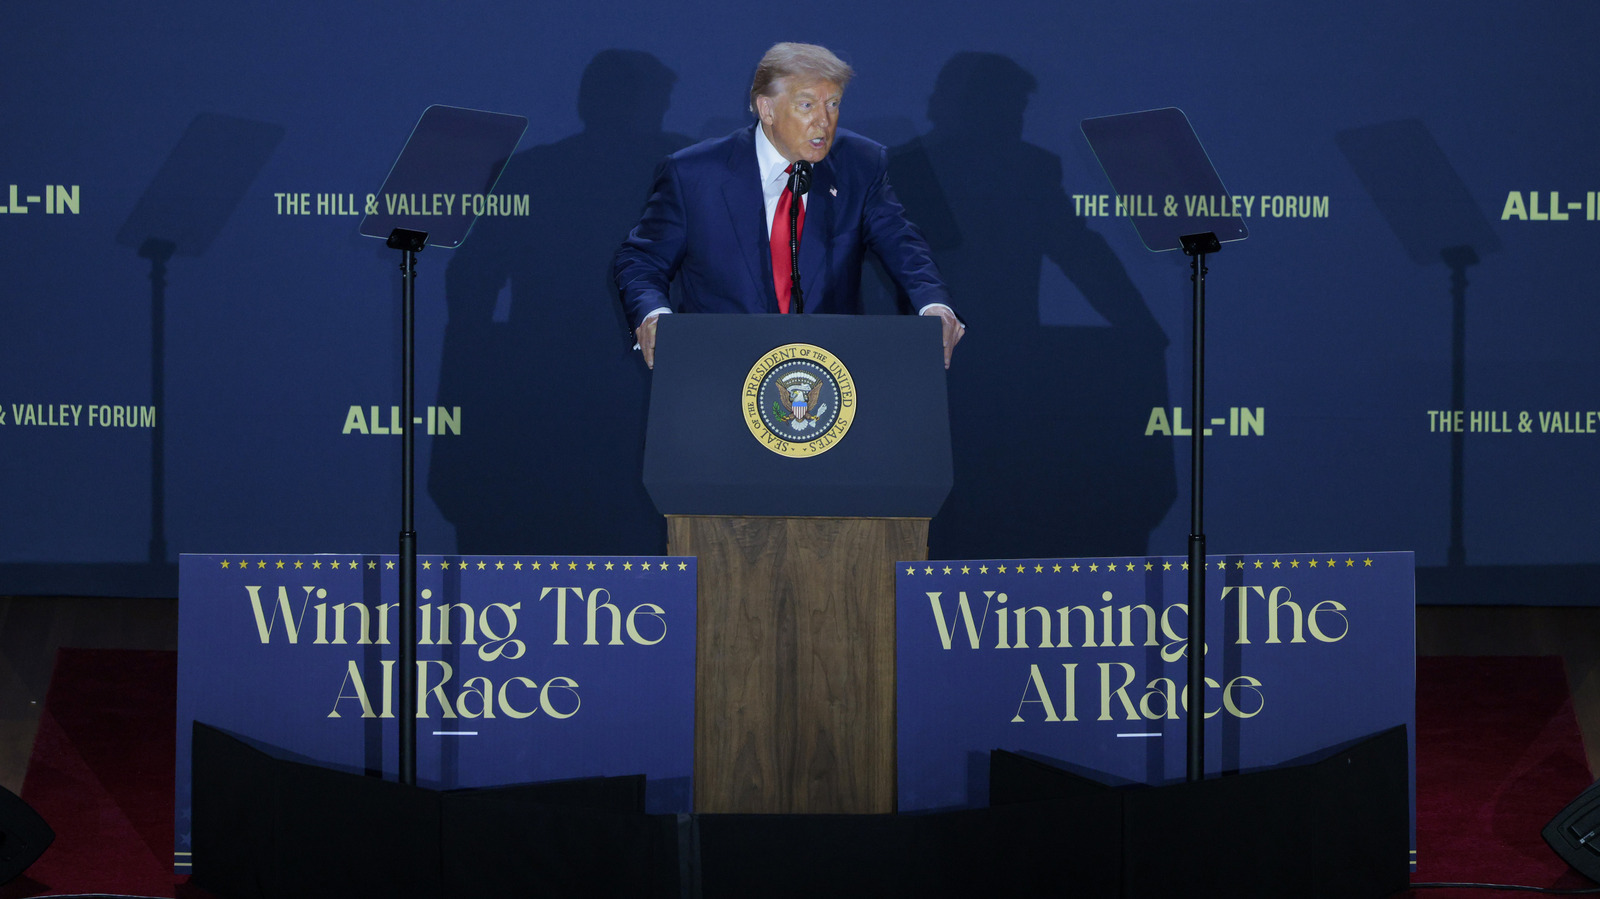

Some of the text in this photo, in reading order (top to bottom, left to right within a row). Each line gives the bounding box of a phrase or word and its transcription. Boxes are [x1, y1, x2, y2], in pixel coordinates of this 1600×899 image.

[274, 193, 530, 217] THE HILL & VALLEY FORUM
[1072, 194, 1330, 218] THE HILL & VALLEY FORUM
[1501, 190, 1600, 221] ALL-I
[745, 347, 853, 452] SEAL OF THE PRESIDENT OF THE UNITED STATES
[12, 403, 83, 426] VALLEY
[88, 404, 156, 428] FORUM
[342, 405, 461, 436] ALL-IN
[1427, 410, 1600, 433] THE HILL & VALLE
[539, 587, 668, 646] The
[925, 586, 1349, 663] Winning The
[327, 660, 581, 719] AI Race
[1011, 662, 1265, 722] AI Race
